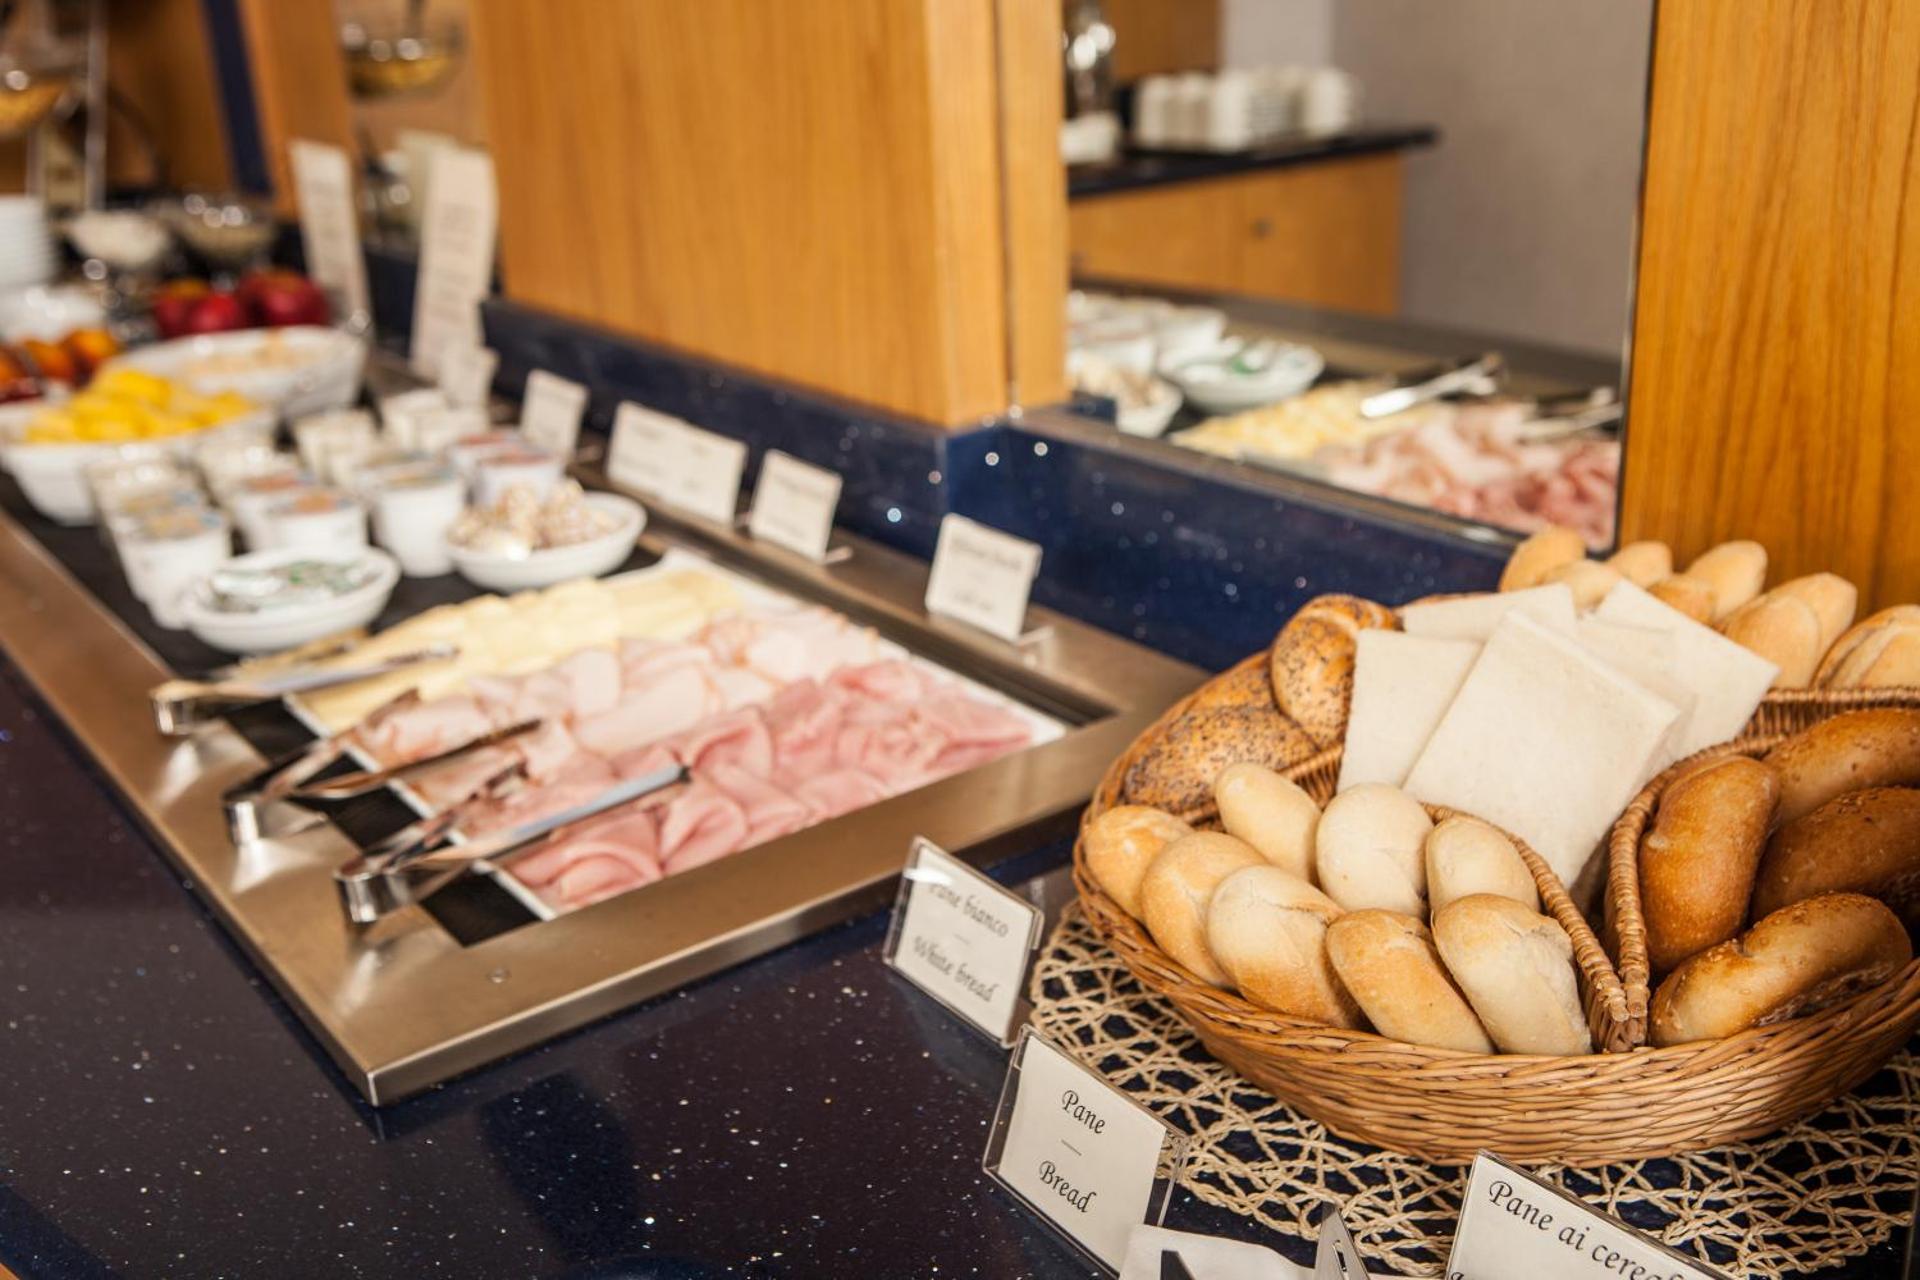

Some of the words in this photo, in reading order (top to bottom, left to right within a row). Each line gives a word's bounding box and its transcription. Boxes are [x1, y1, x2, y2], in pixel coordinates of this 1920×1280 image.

[963, 894, 1009, 937] bianco
[913, 935, 953, 975] White
[955, 963, 999, 1002] bread
[1061, 1090, 1106, 1134] Pane
[1039, 1160, 1097, 1213] Bread
[1488, 1180, 1553, 1230] Pane
[1558, 1227, 1590, 1251] ai
[1592, 1245, 1684, 1280] cere
